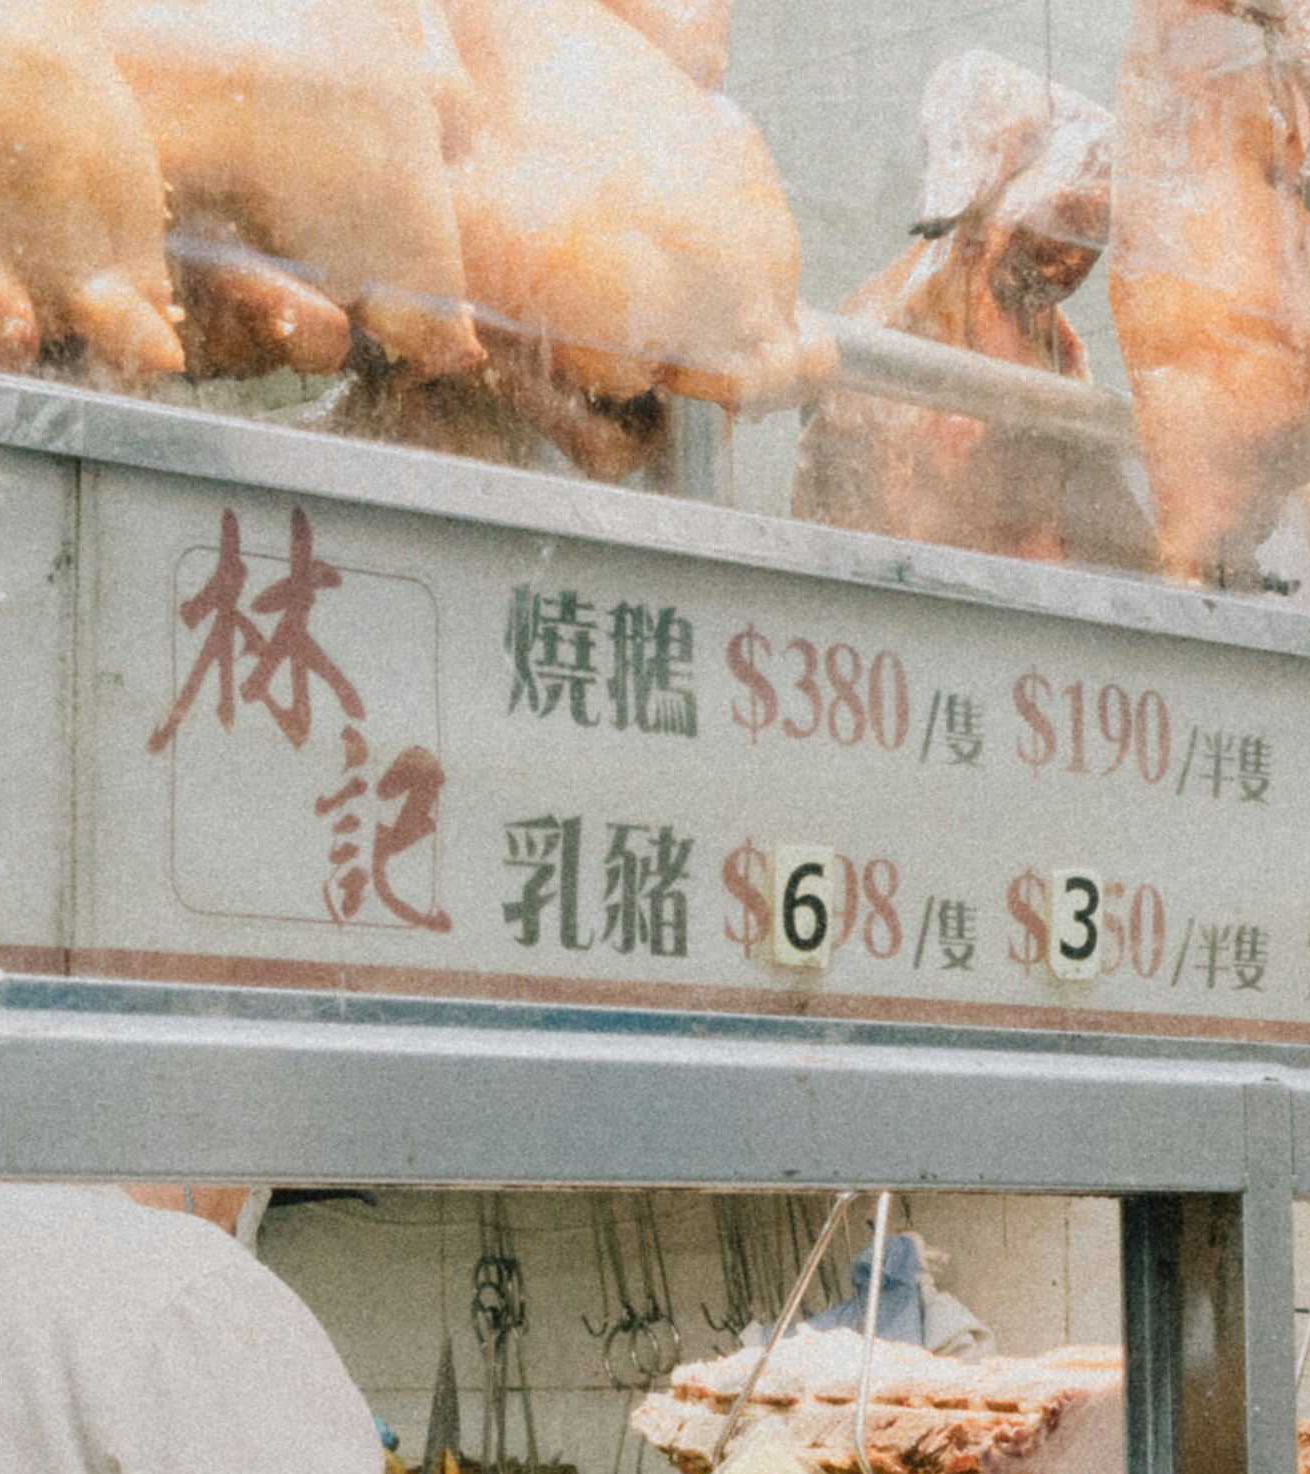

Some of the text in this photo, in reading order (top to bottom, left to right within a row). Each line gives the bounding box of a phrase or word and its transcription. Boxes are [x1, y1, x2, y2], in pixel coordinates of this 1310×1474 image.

[147, 507, 452, 934] 林記
[503, 584, 699, 738] 燒鵝
[501, 813, 695, 958] 乳豬
